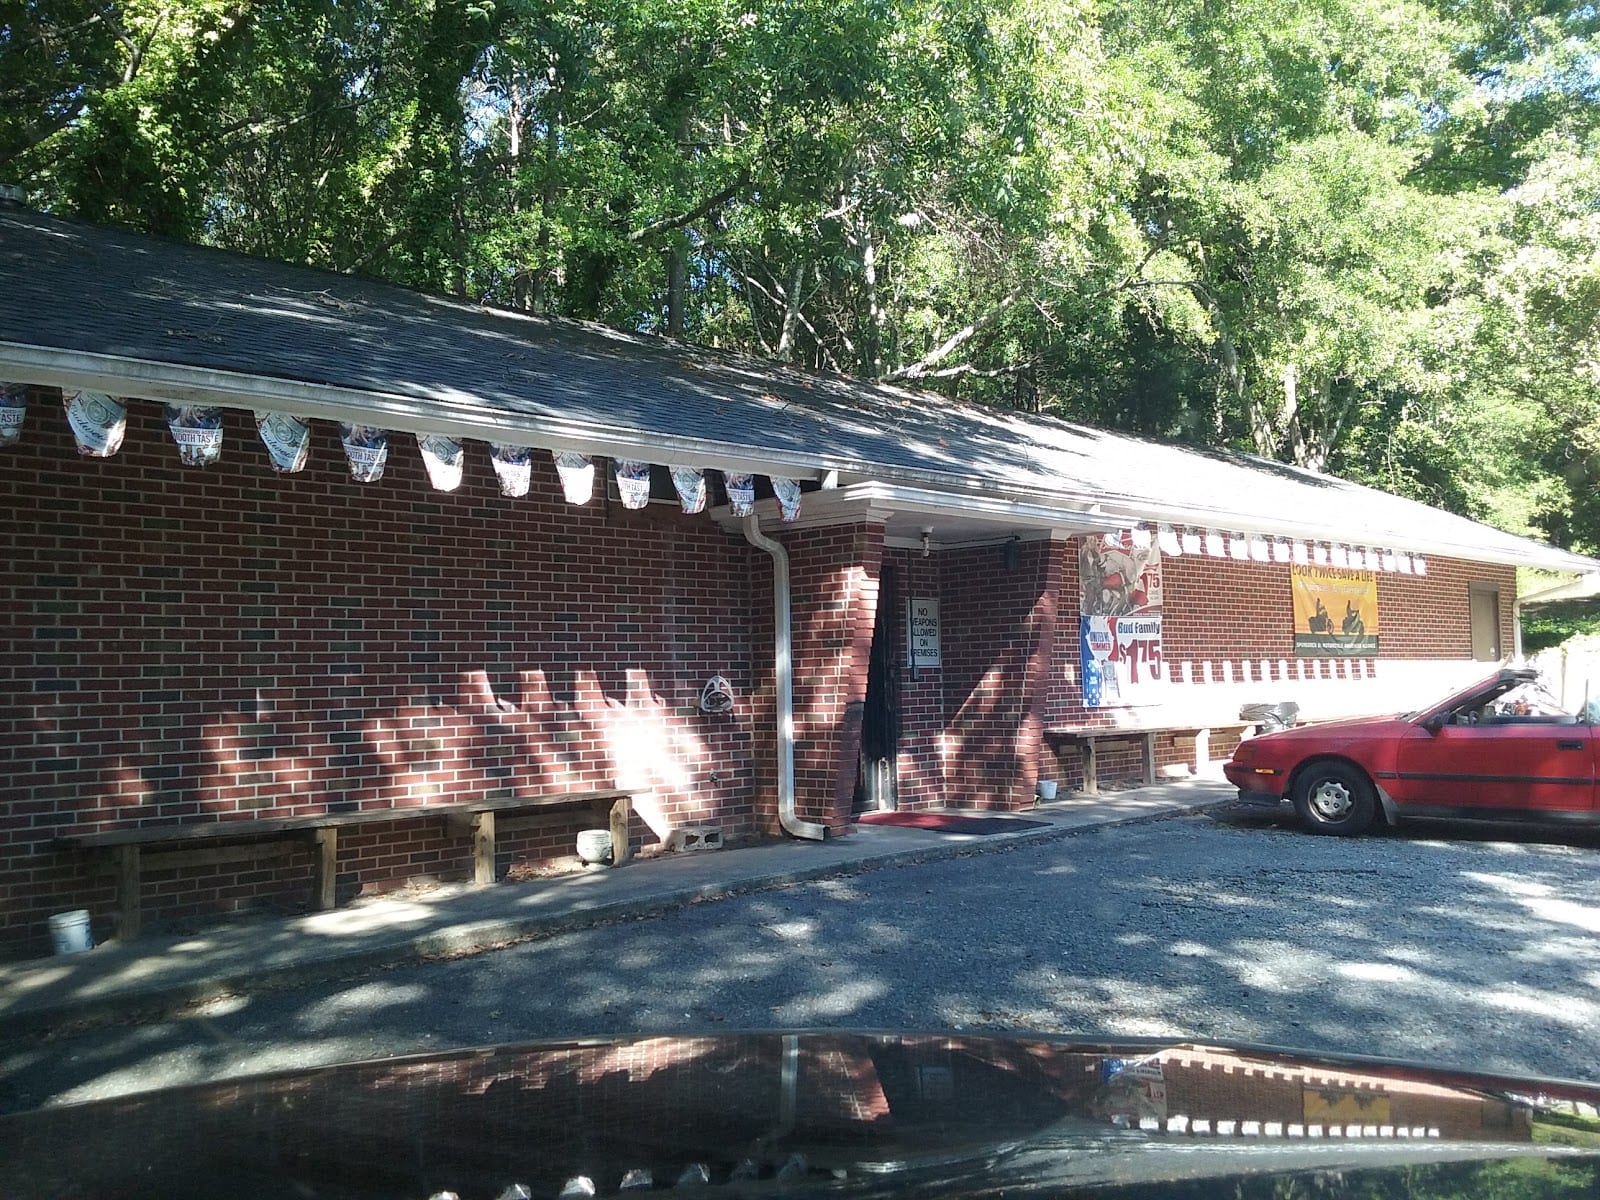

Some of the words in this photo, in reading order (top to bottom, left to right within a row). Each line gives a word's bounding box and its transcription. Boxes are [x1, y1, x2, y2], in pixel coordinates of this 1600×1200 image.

[918, 607, 928, 616] NO
[912, 617, 937, 627] EAPONS
[912, 628, 937, 637] LLOWED
[1118, 622, 1134, 634] Bud
[1135, 622, 1160, 635] Family
[919, 638, 929, 647] ON
[911, 648, 938, 657] REMISES
